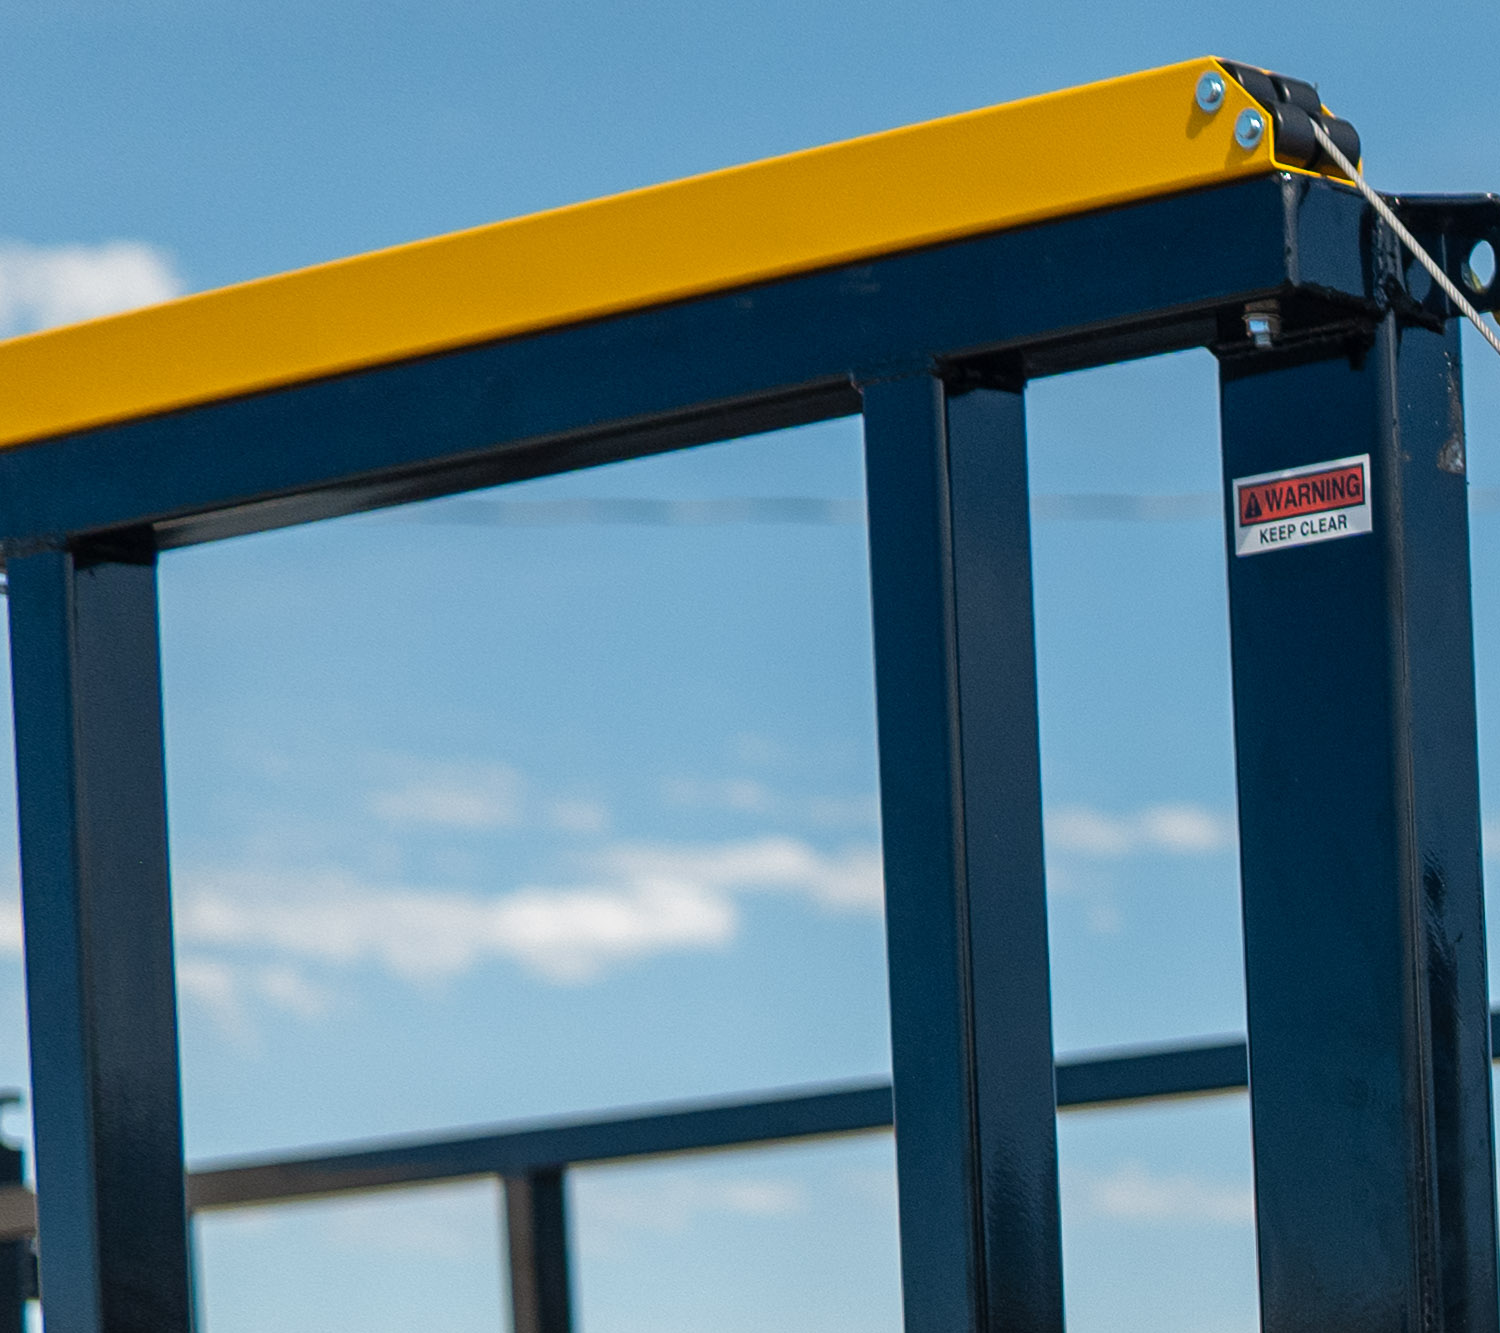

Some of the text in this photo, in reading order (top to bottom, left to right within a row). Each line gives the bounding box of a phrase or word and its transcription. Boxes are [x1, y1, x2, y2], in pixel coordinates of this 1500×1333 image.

[1265, 474, 1360, 512] WARNING
[1260, 514, 1347, 544] KEEP CLEAR
